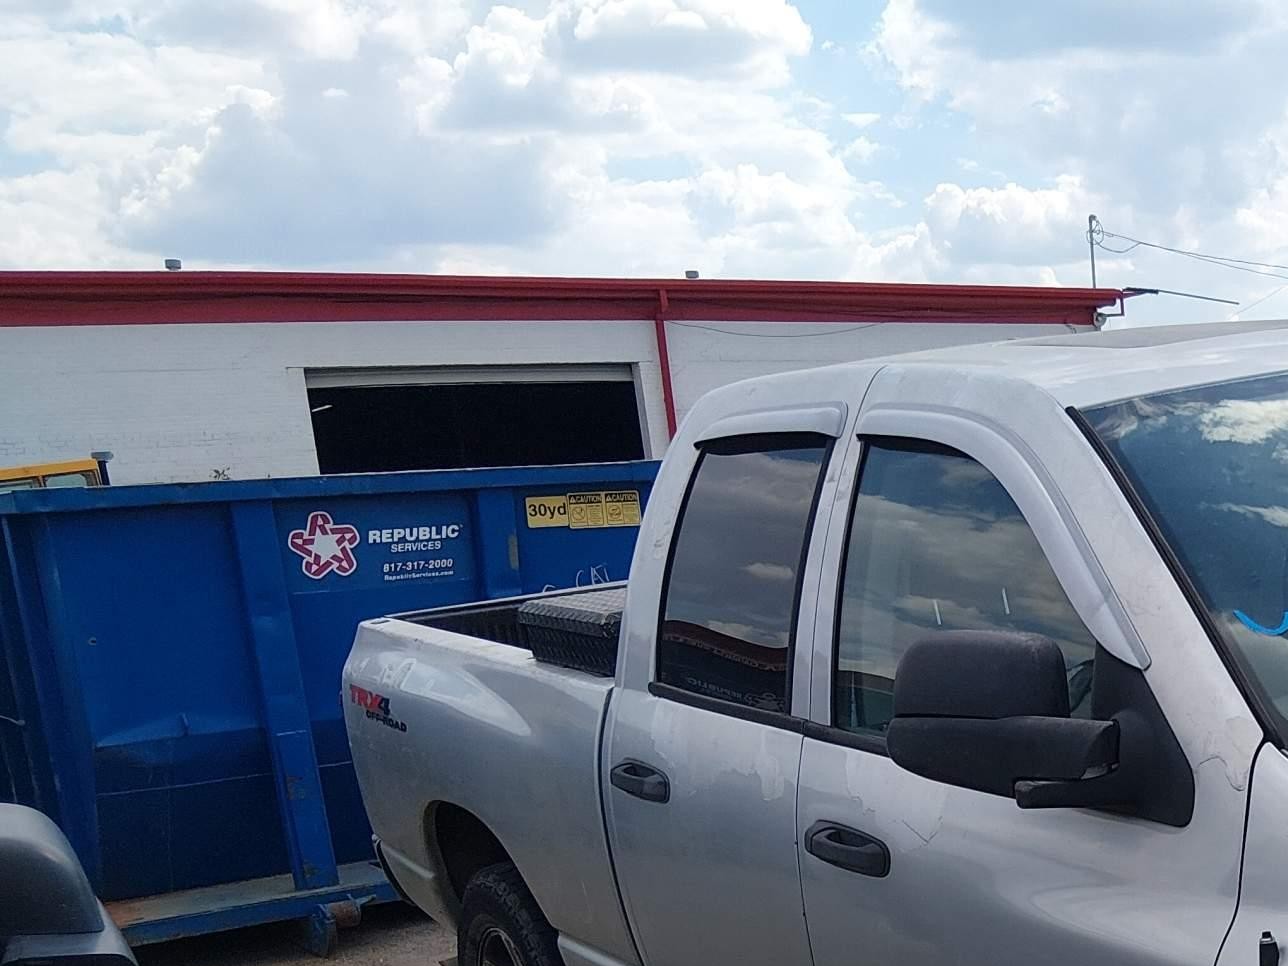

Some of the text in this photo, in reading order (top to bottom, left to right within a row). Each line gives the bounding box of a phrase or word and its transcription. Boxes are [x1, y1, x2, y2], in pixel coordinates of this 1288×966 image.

[528, 503, 567, 519] 30yd
[368, 524, 459, 544] REPUBLIC
[390, 540, 441, 553] SERVICES
[383, 558, 453, 573] 817-317-2000
